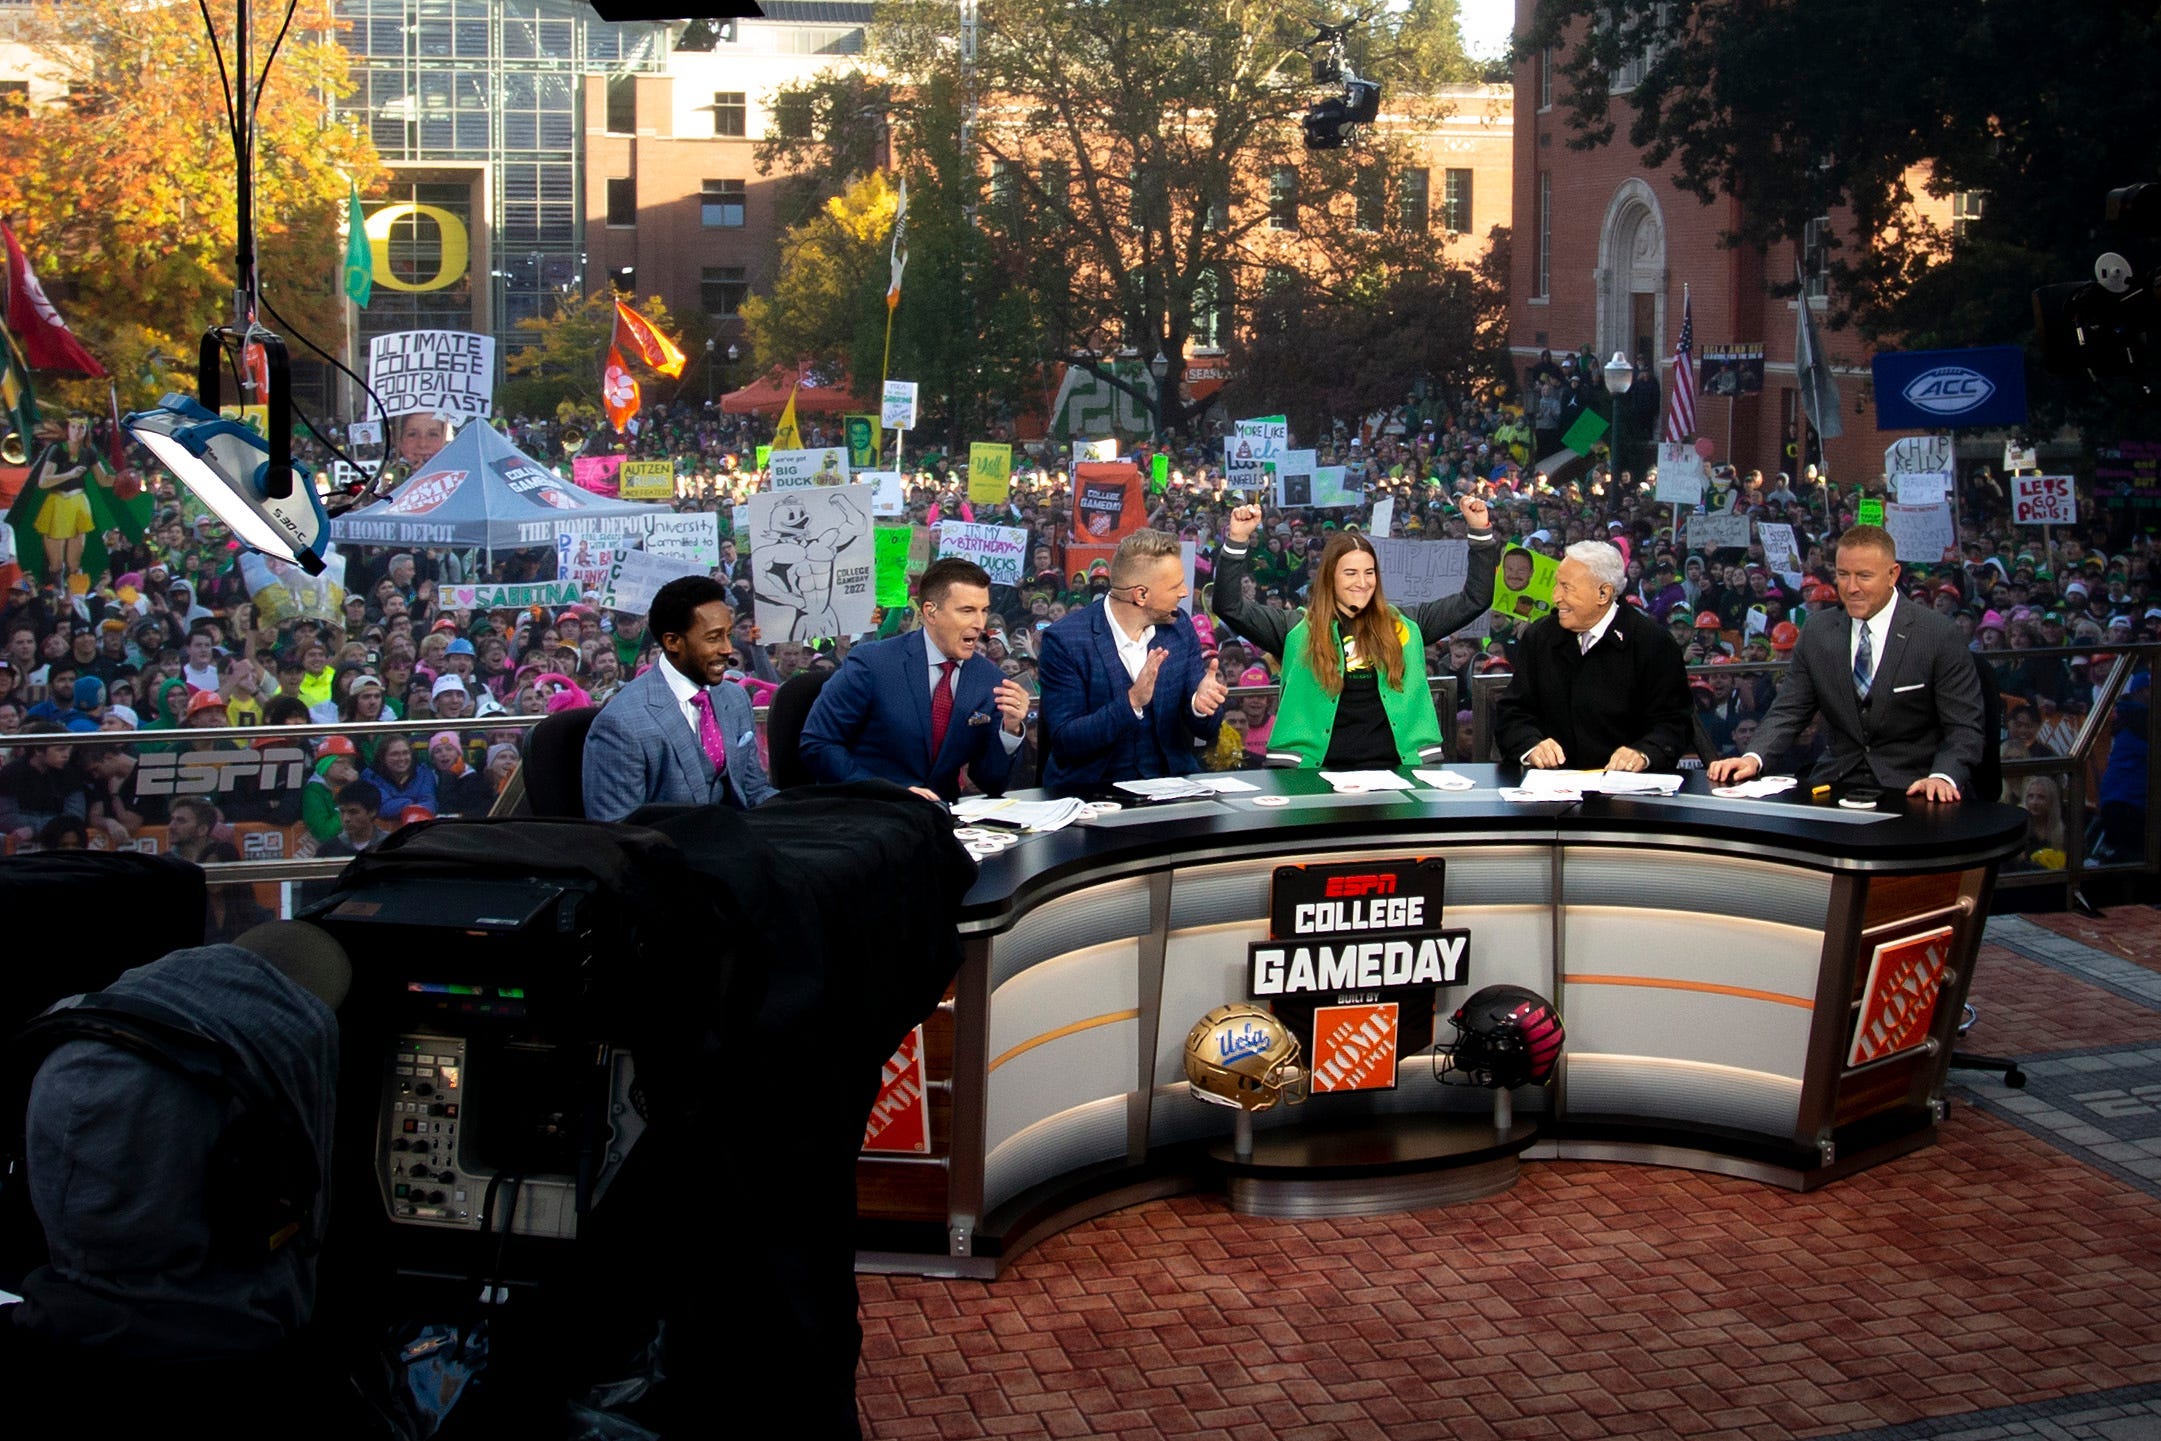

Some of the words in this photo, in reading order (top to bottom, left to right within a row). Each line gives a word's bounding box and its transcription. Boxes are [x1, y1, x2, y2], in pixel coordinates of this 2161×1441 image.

[365, 204, 469, 292] O
[377, 333, 481, 357] ULTIMATE
[375, 352, 482, 378] COLLEGE
[375, 372, 481, 396] FOOTBALL
[1919, 378, 1981, 397] ACC
[374, 393, 490, 416] PODCAST
[1236, 423, 1262, 439] MORE
[1264, 424, 1285, 439] LIKE
[1895, 437, 1949, 459] CHIP
[624, 463, 670, 477] AUTZEN
[776, 466, 797, 476] BIG
[1895, 455, 1949, 471] KELLY
[777, 477, 812, 487] DUCK
[2020, 478, 2068, 497] LET'S
[1080, 497, 1122, 511] GAMEDAY
[2033, 495, 2056, 508] GO
[349, 520, 396, 541] HOME
[400, 522, 456, 542] DEPOT
[518, 521, 551, 542] THE
[554, 517, 597, 540] HOME
[645, 515, 713, 536] University
[985, 526, 1000, 540] MY
[980, 555, 1017, 571] DUCKS
[837, 575, 869, 585] GAMEDAY
[844, 583, 865, 594] 2022
[1404, 576, 1434, 598] IS
[441, 587, 456, 605] I
[476, 582, 581, 609] SABRINA
[135, 747, 305, 796] ESPN
[1325, 873, 1398, 898] ESPN
[1295, 896, 1425, 934] COLLEGE
[1253, 937, 1467, 996] GAMEDAY
[1338, 992, 1365, 1004] BUILT
[1366, 991, 1380, 1003] BY
[1315, 1007, 1397, 1092] HOME
